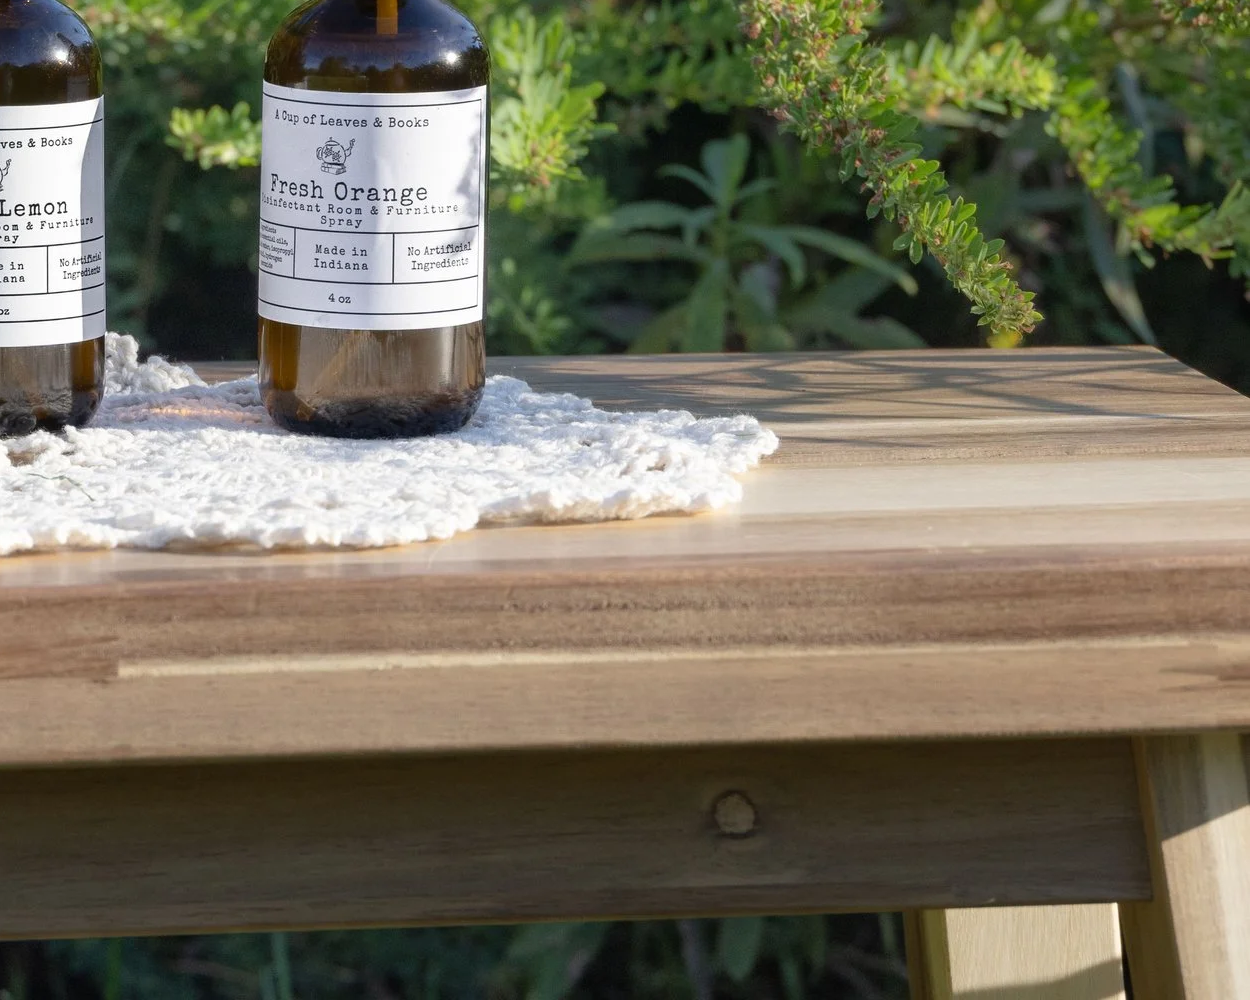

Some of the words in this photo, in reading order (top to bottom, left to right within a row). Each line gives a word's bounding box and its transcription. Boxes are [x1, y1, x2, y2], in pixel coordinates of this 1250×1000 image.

[275, 110, 279, 119] A
[282, 111, 299, 125] Cup
[303, 114, 317, 124] of
[321, 115, 367, 127] Leaves
[374, 118, 382, 127] &
[388, 117, 429, 127] Books
[28, 139, 35, 147] &
[41, 137, 73, 147] Books
[271, 174, 324, 199] Fresh
[334, 182, 428, 206] Orange
[328, 204, 362, 214] Room
[370, 206, 378, 214] &
[387, 204, 458, 215] Furniture
[26, 221, 33, 229] &
[40, 217, 93, 229] Furniture
[321, 216, 362, 228] Spray
[315, 245, 345, 255] Made
[352, 248, 367, 256] in
[408, 247, 420, 256] No
[424, 242, 471, 255] Artificial
[10, 262, 24, 270] in
[60, 259, 69, 267] No
[314, 259, 368, 270] Indiana
[412, 258, 468, 271] Ingredients
[63, 266, 100, 280] Ingredients
[328, 294, 334, 302] 4
